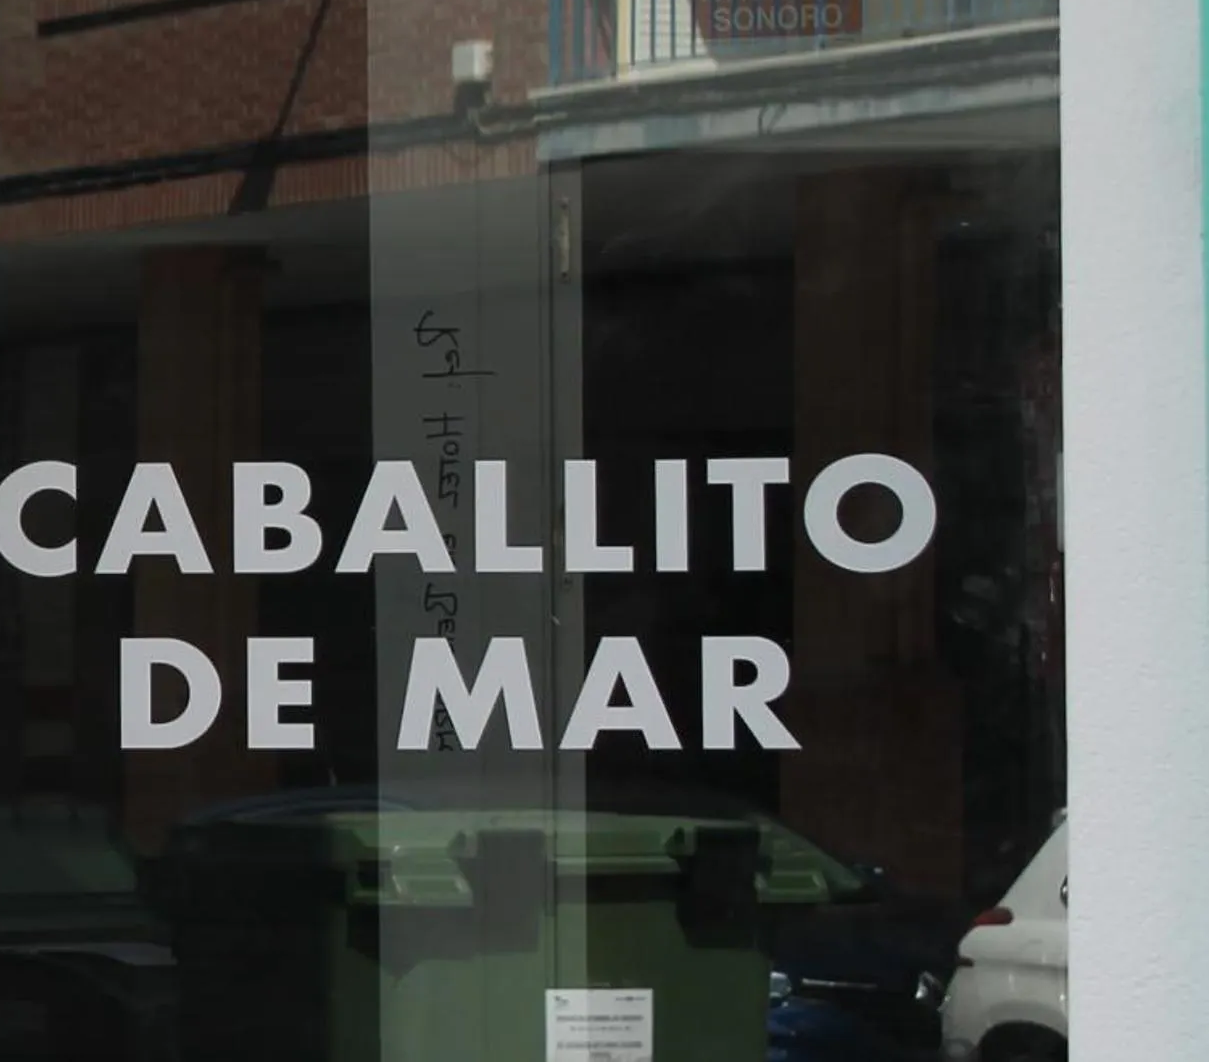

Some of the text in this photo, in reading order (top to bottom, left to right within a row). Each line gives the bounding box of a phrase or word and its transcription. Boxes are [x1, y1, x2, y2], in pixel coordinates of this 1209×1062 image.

[713, 3, 843, 32] SONORO
[120, 636, 802, 750] DE MAR
